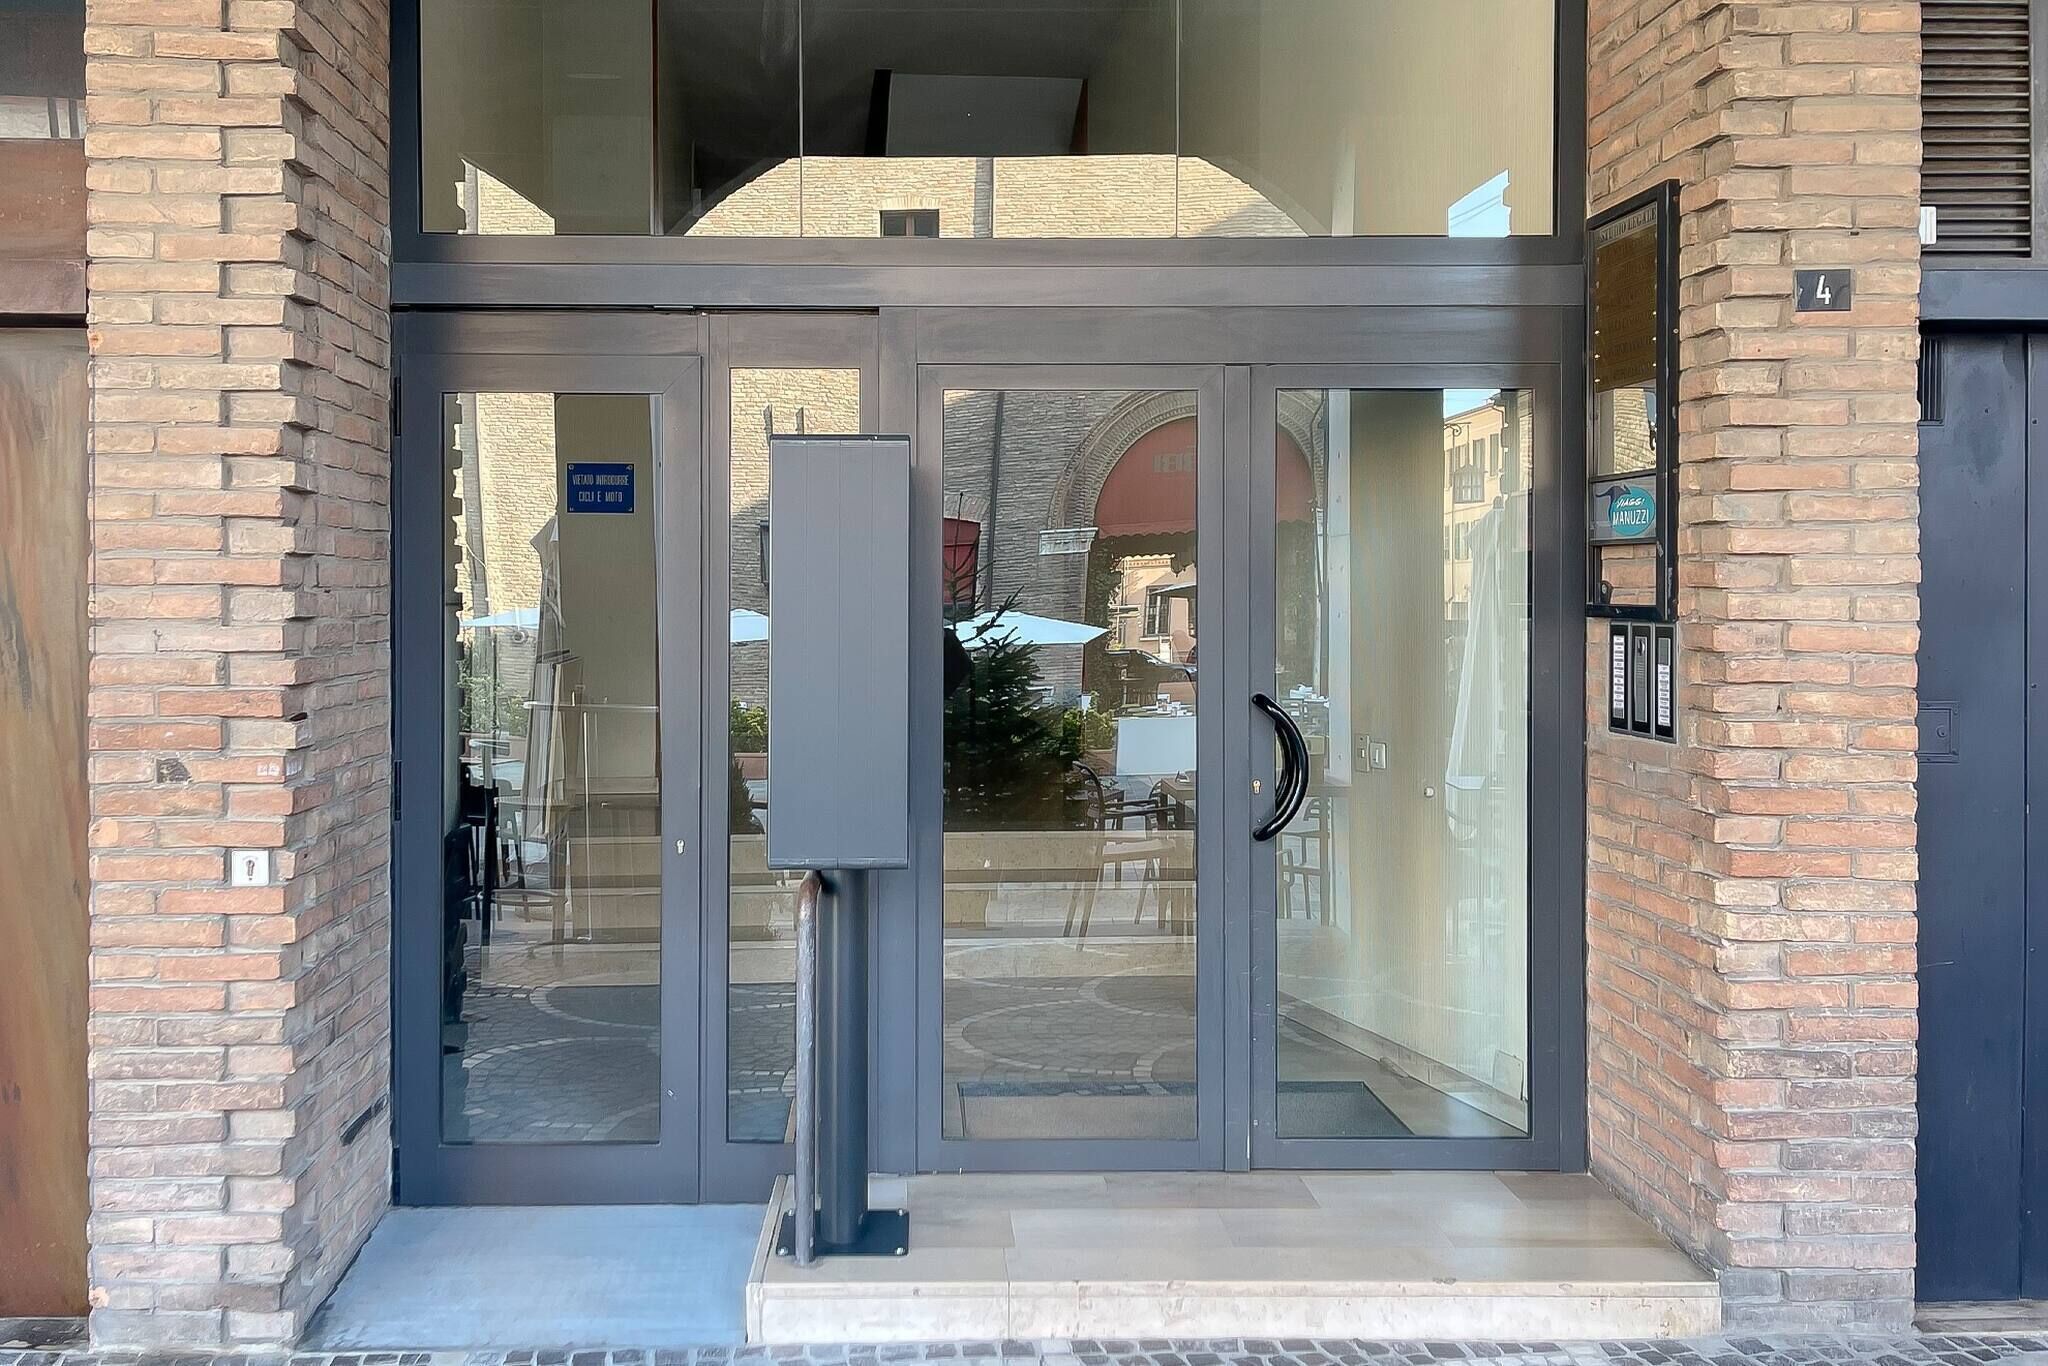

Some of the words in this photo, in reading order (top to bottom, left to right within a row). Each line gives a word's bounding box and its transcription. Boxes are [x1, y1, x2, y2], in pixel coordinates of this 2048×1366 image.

[1627, 208, 1657, 231] LEGALE
[1816, 275, 1831, 304] 4
[572, 474, 594, 486] VIETATO
[578, 491, 595, 502] CICLI
[597, 491, 602, 502] E
[605, 491, 623, 502] MOTO
[1615, 497, 1646, 508] VIAGGI
[1612, 508, 1649, 526] MANUZZI
